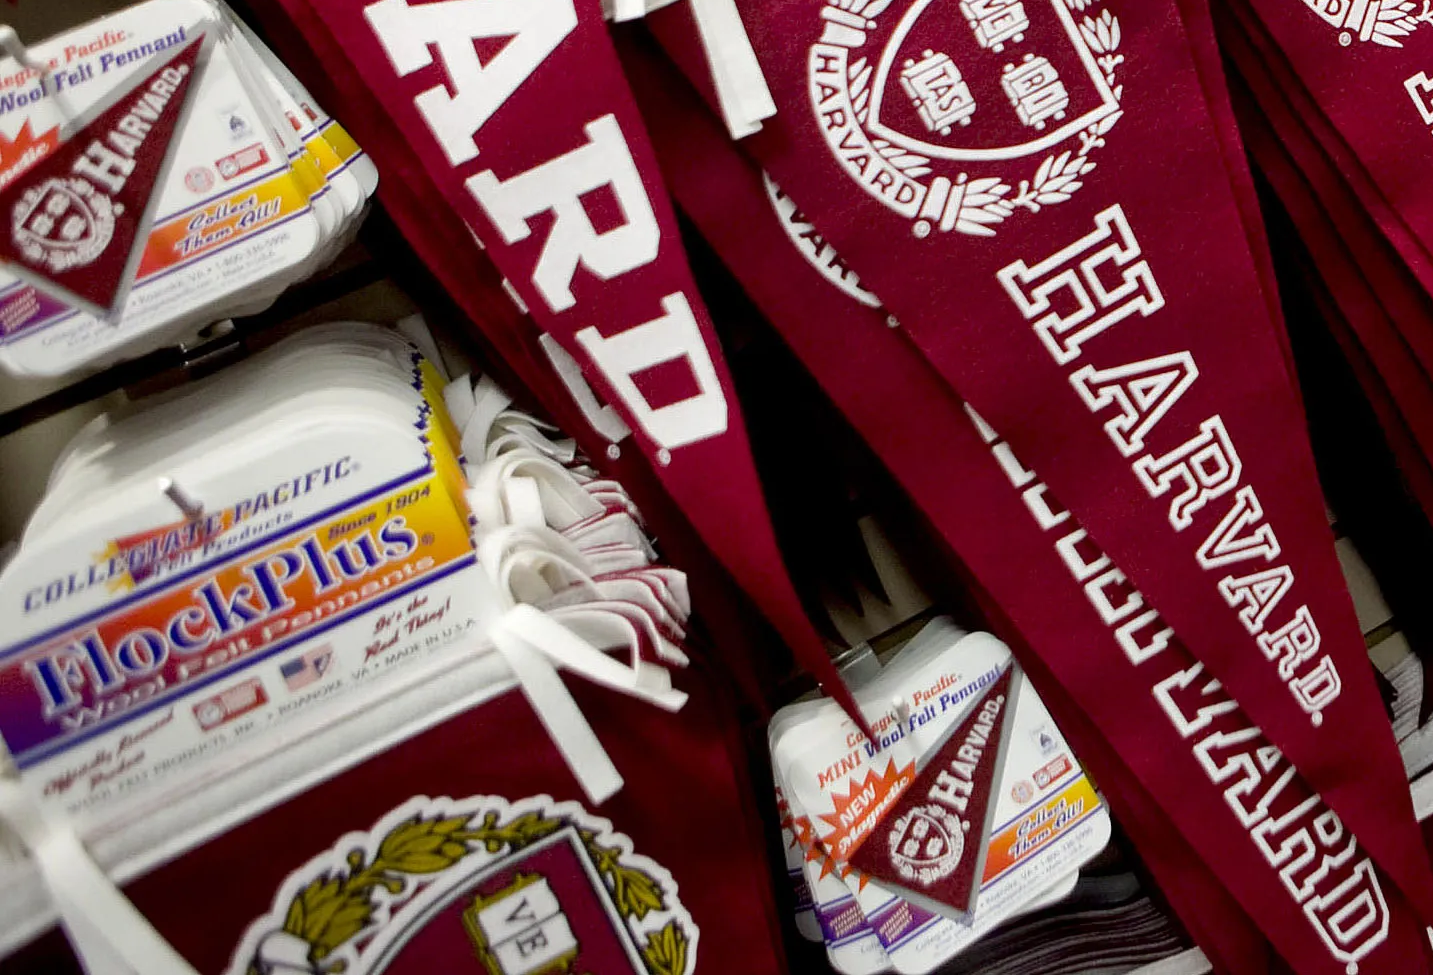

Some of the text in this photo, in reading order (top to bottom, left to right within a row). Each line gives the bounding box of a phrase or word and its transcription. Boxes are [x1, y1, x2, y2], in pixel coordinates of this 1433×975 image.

[54, 62, 94, 93] Felt
[100, 26, 187, 73] Pennant
[63, 29, 127, 63] Pacific
[73, 67, 183, 194] HARVARD
[814, 53, 917, 205] HARVARD
[174, 225, 233, 257] Them
[189, 194, 257, 232] Collect
[385, 483, 432, 518] 1904
[998, 204, 1342, 716] HARVARD
[22, 506, 226, 615] COLLEGIATE
[262, 555, 436, 643] Pennants
[25, 515, 419, 724] FlockPlus
[817, 750, 862, 789] MINI
[908, 705, 937, 733] Felt
[928, 699, 1000, 812] HARVARD
[839, 781, 876, 827] NEW
